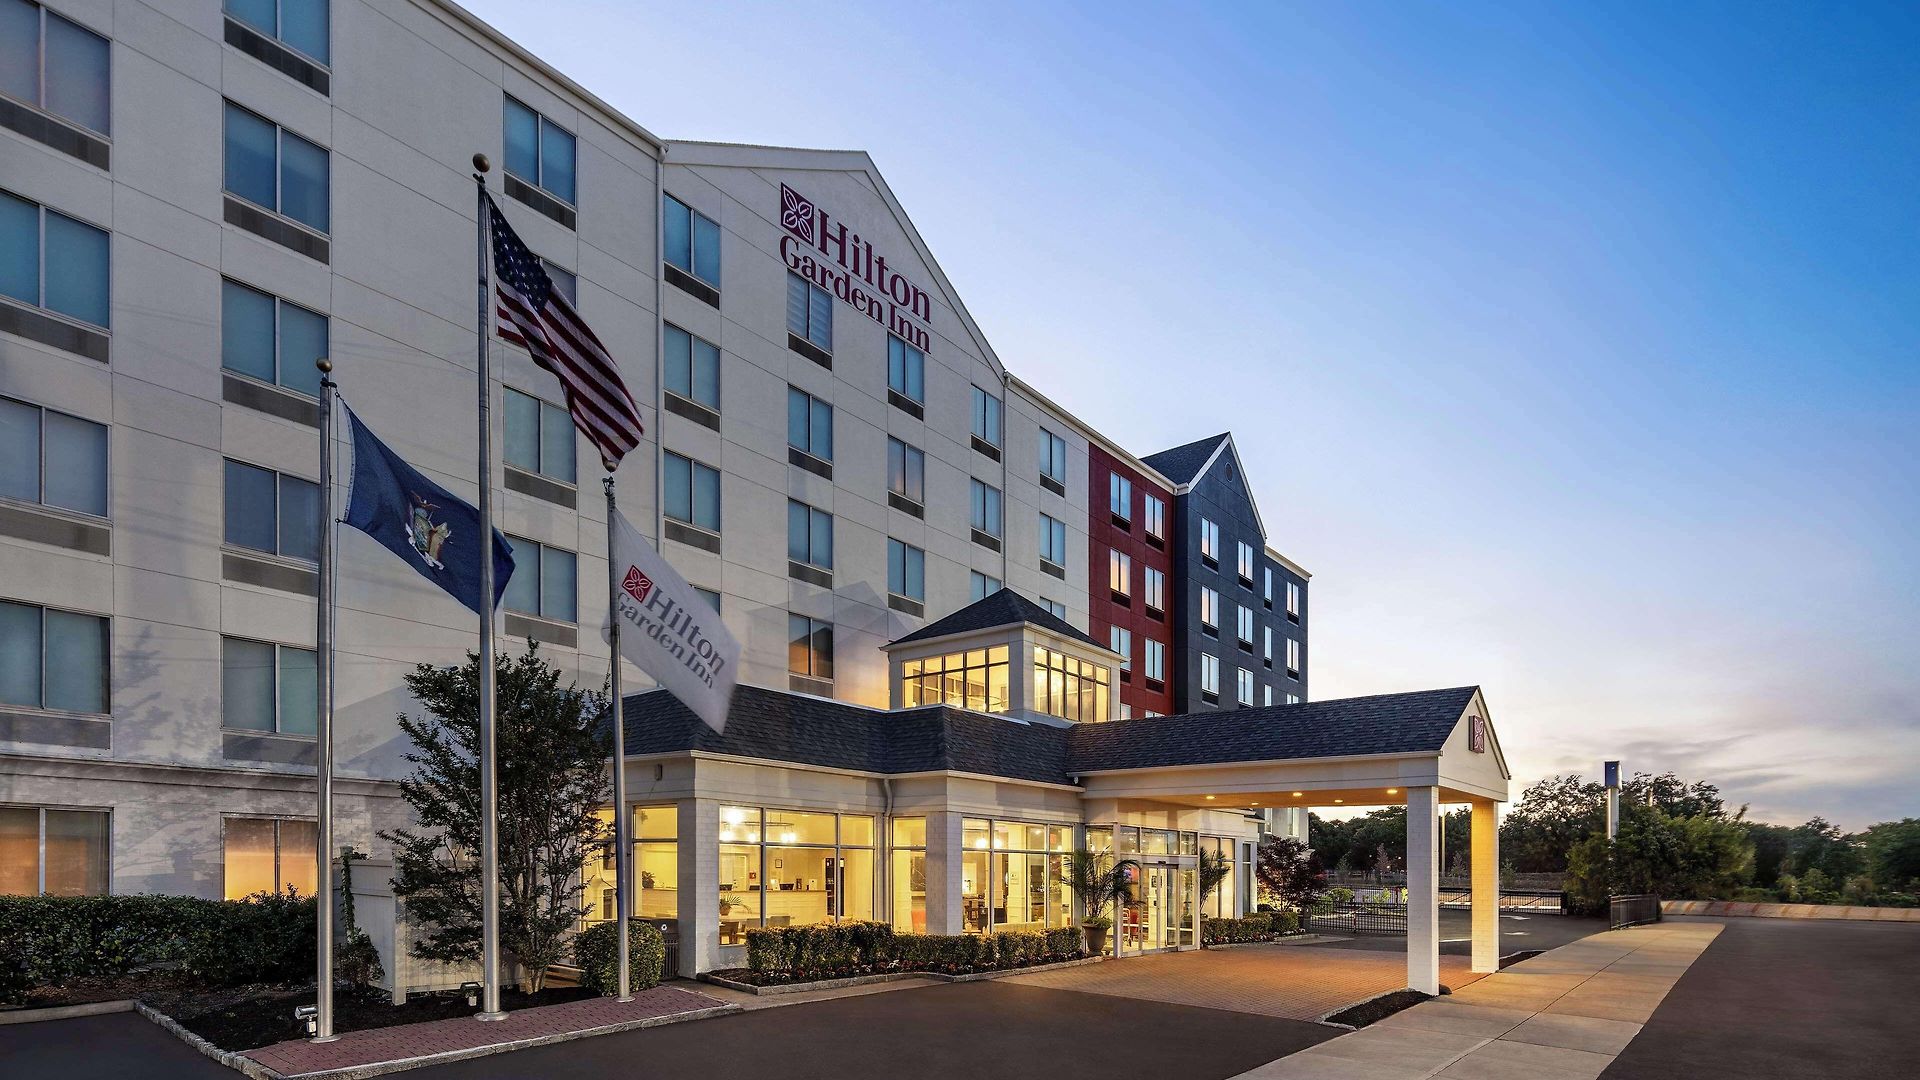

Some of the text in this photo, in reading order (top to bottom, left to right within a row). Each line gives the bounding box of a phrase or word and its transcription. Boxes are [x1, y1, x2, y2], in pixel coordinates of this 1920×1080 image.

[780, 235, 931, 354] Garden Inn
[818, 209, 931, 324] Hilton
[645, 586, 725, 675] Hilton
[684, 651, 713, 688] Inn
